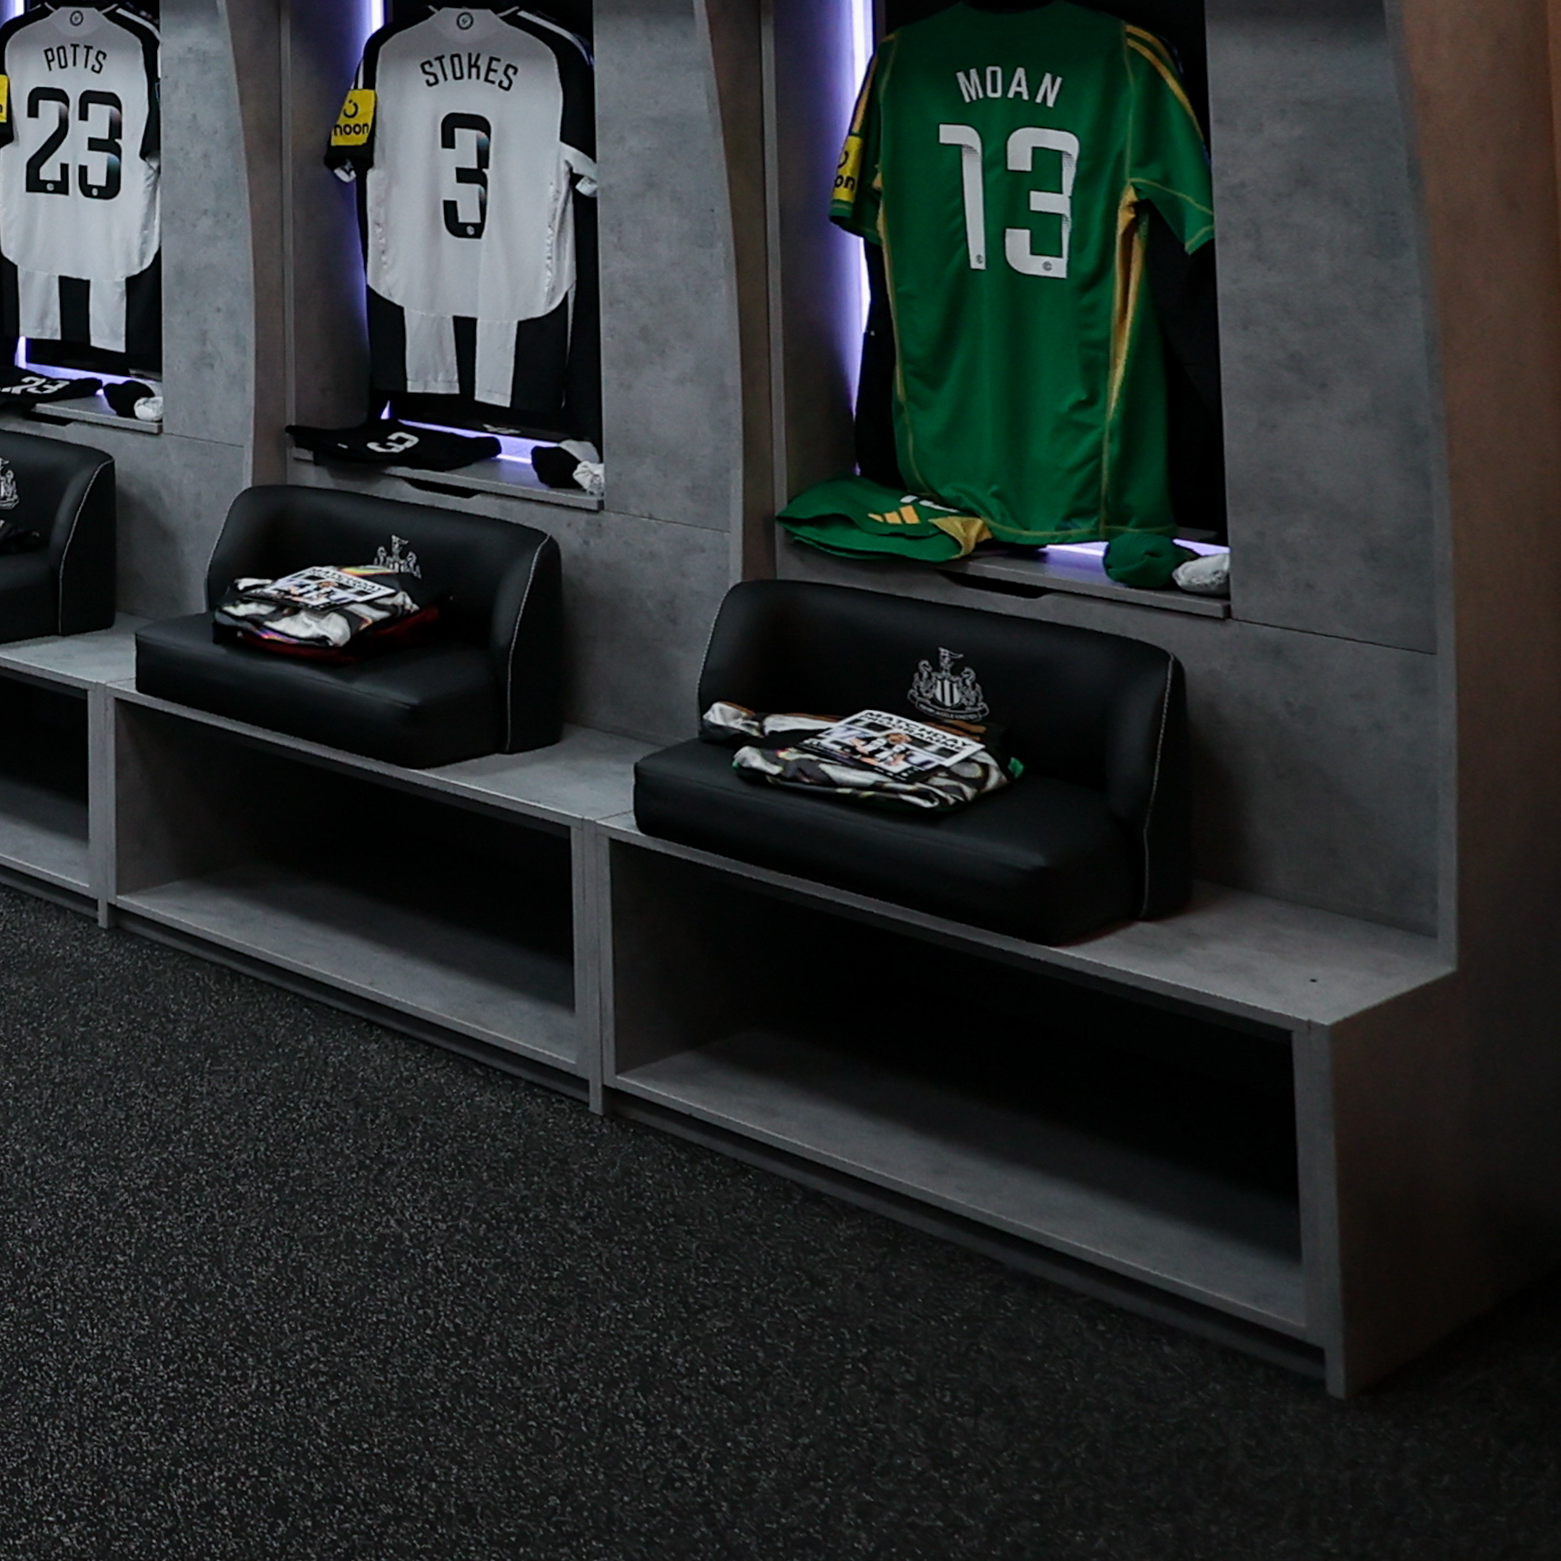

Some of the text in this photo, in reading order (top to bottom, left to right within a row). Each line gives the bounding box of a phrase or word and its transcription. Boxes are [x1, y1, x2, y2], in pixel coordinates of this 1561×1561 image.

[43, 43, 108, 74] POTTS
[420, 52, 519, 92] STOKES
[955, 66, 1063, 108] MOAN
[26, 86, 122, 200] 23
[333, 123, 370, 136] noon
[441, 112, 492, 240] 3
[834, 174, 855, 191] on
[939, 124, 1080, 279] 13
[11, 376, 71, 395] 23
[864, 712, 972, 747] MATCHDAY
